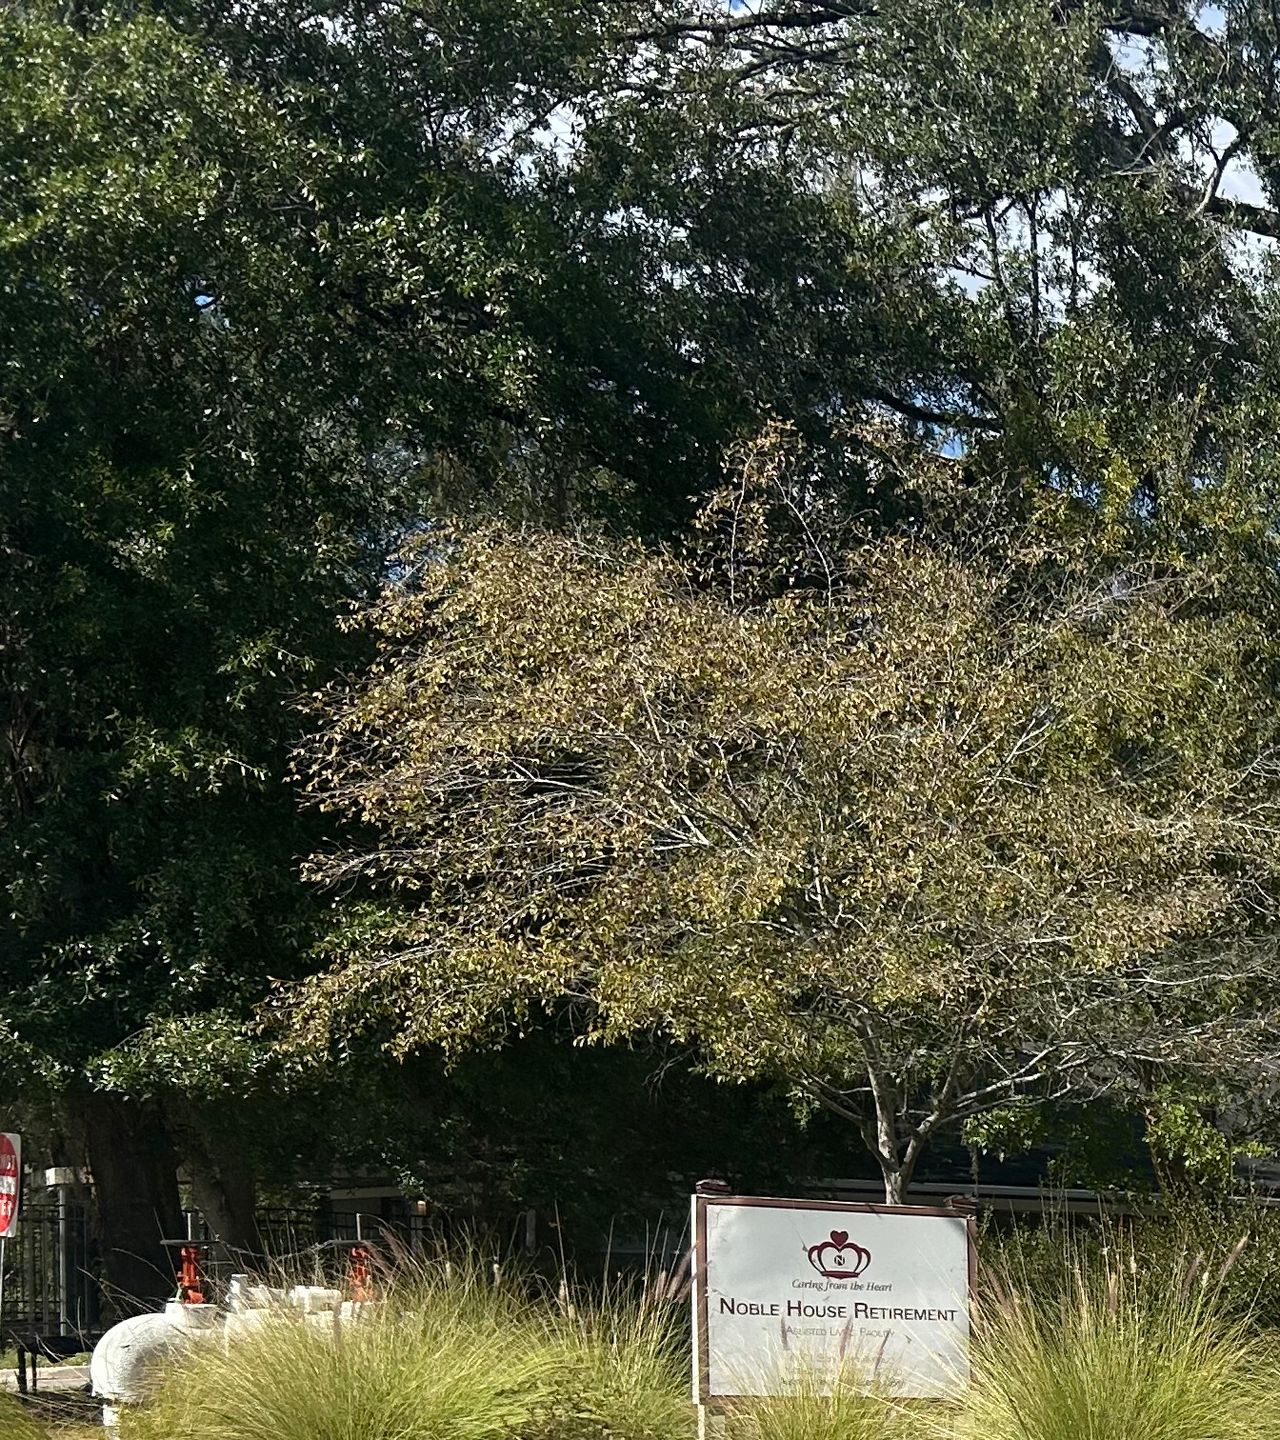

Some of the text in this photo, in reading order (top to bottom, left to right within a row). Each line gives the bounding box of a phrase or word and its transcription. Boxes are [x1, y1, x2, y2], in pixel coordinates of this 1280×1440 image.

[792, 1279, 893, 1292] Caring from the Heart
[720, 1298, 958, 1321] NOBLE HOUSE RETIREMENT
